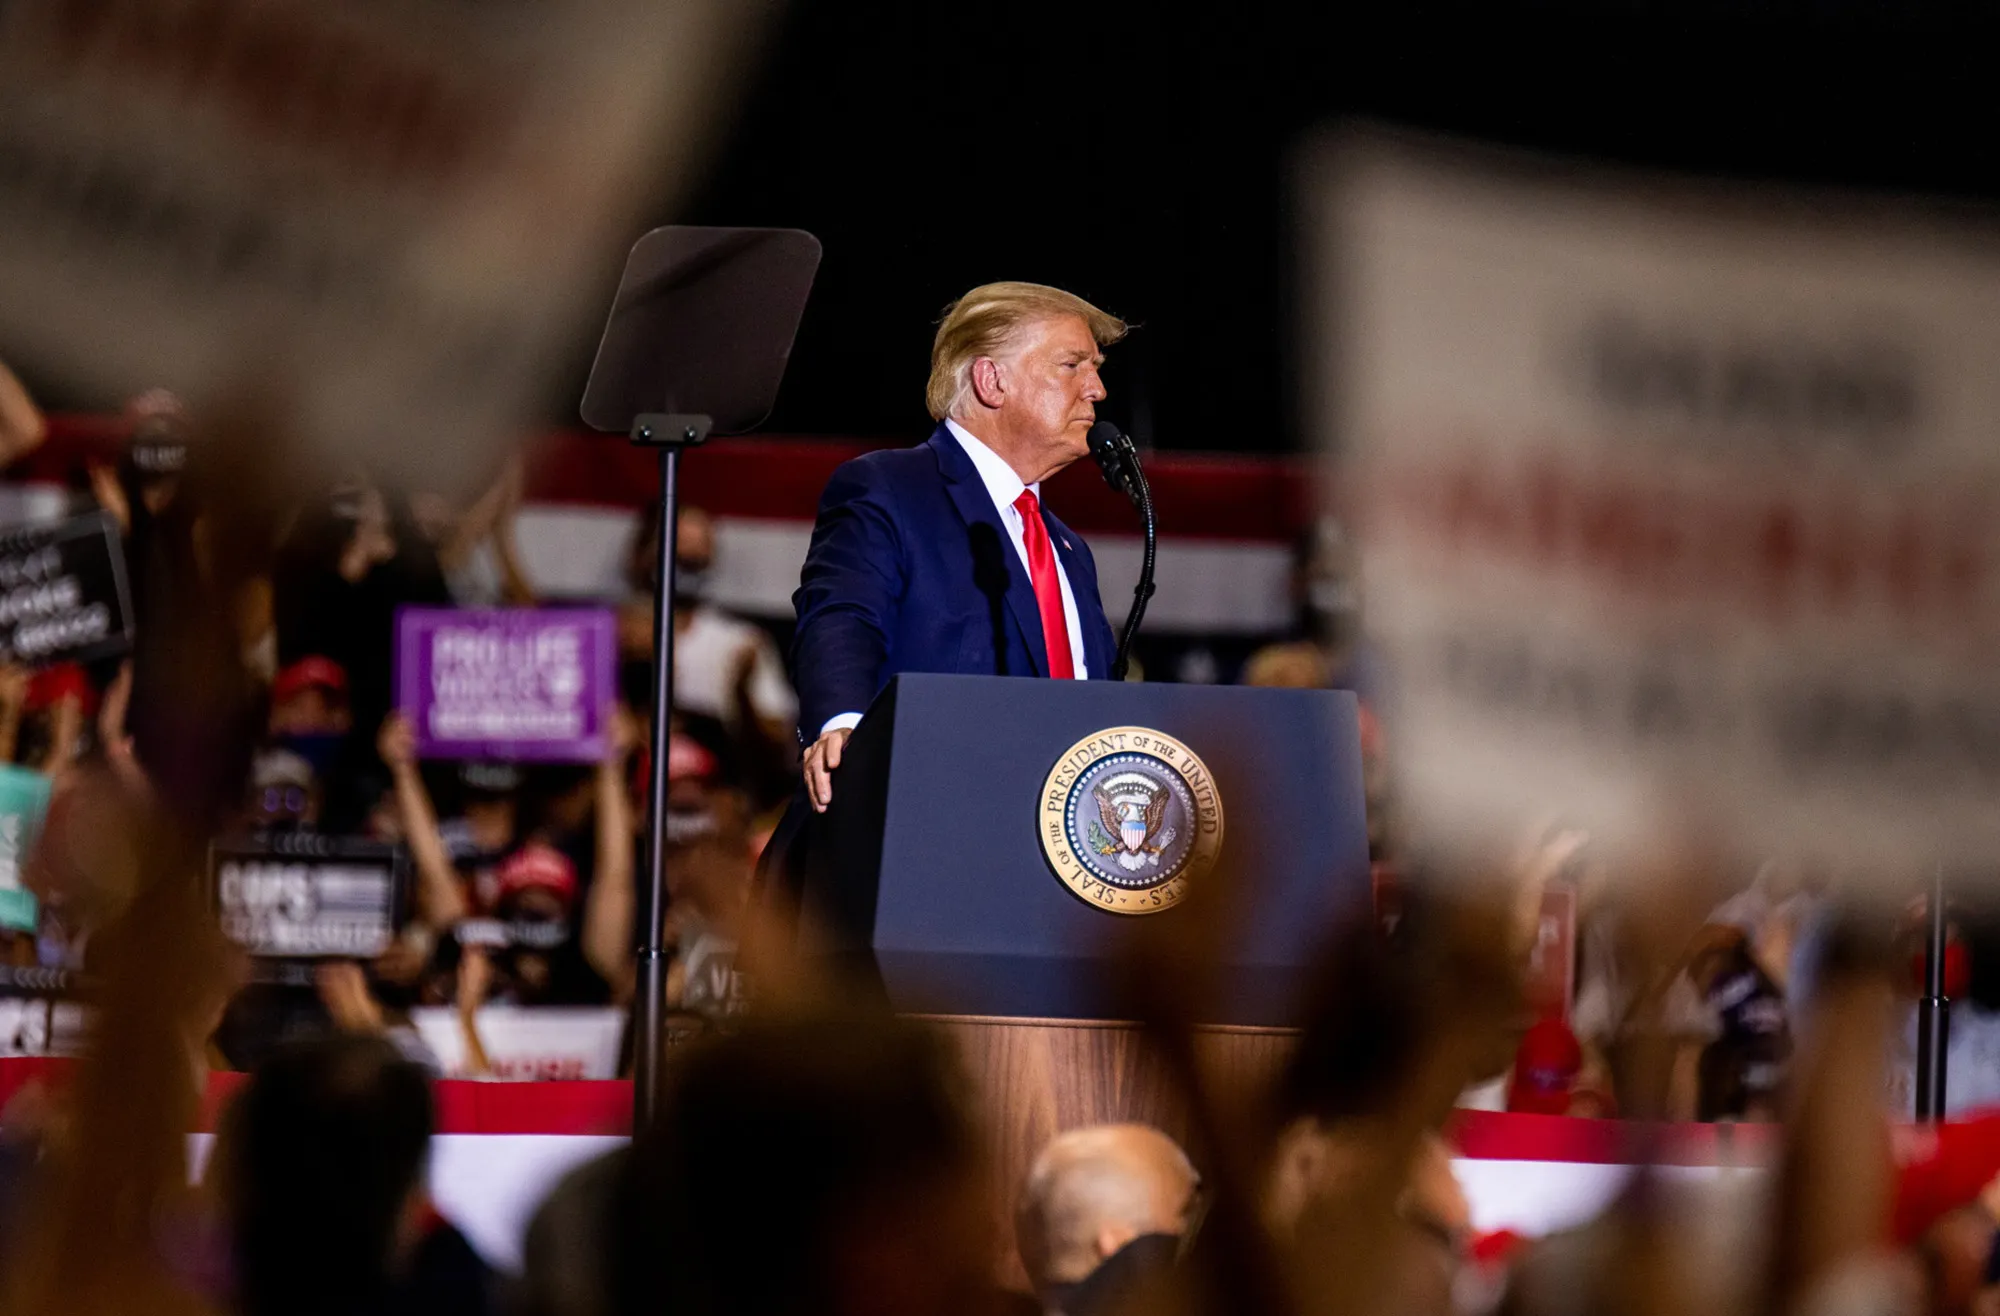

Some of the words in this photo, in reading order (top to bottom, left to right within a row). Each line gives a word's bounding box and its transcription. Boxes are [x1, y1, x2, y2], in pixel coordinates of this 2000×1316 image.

[1133, 736, 1150, 748] OF
[1153, 740, 1177, 760] THE
[1047, 733, 1127, 813] PRESIDENT
[1180, 758, 1217, 834] UNITED
[1049, 821, 1063, 847] THE
[1056, 849, 1071, 865] OF
[1069, 864, 1117, 905] SEAL
